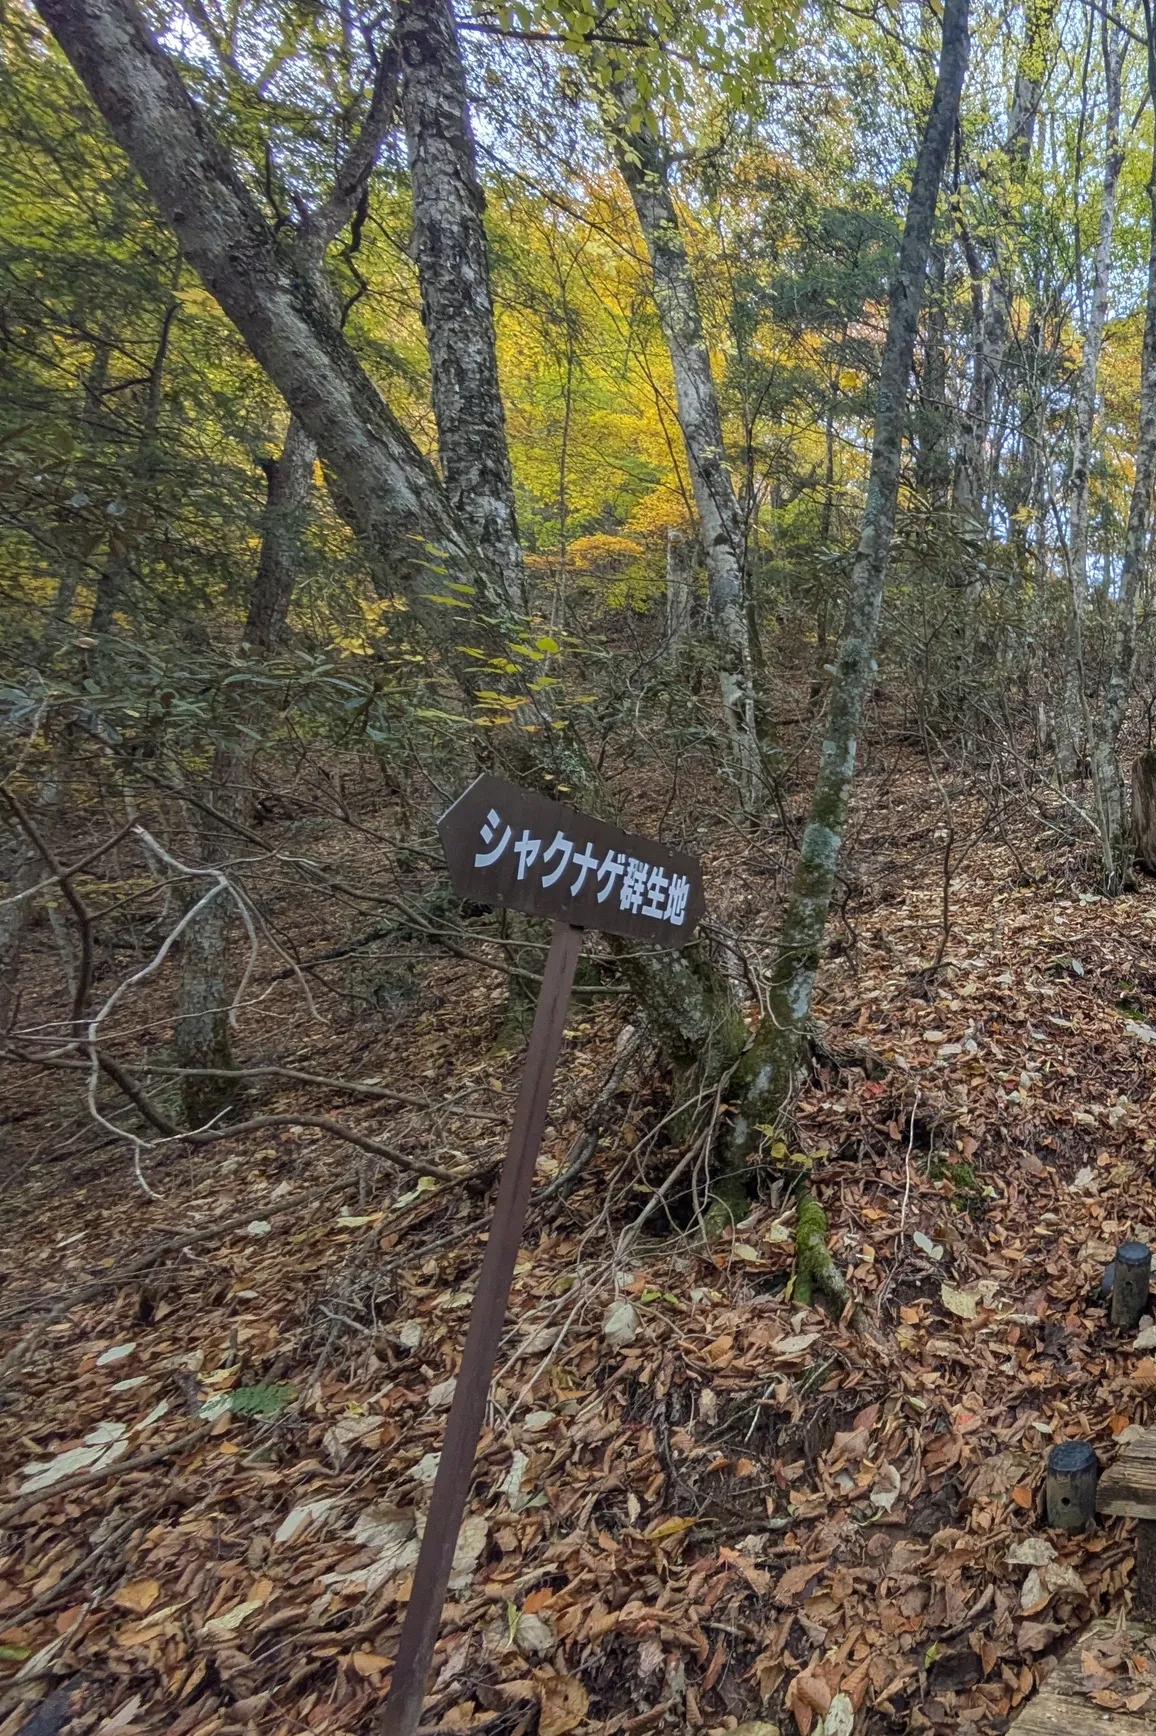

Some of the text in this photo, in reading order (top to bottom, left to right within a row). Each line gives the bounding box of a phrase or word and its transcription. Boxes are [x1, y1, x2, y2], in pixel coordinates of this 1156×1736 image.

[474, 807, 690, 926] シャクナゲ群生地
